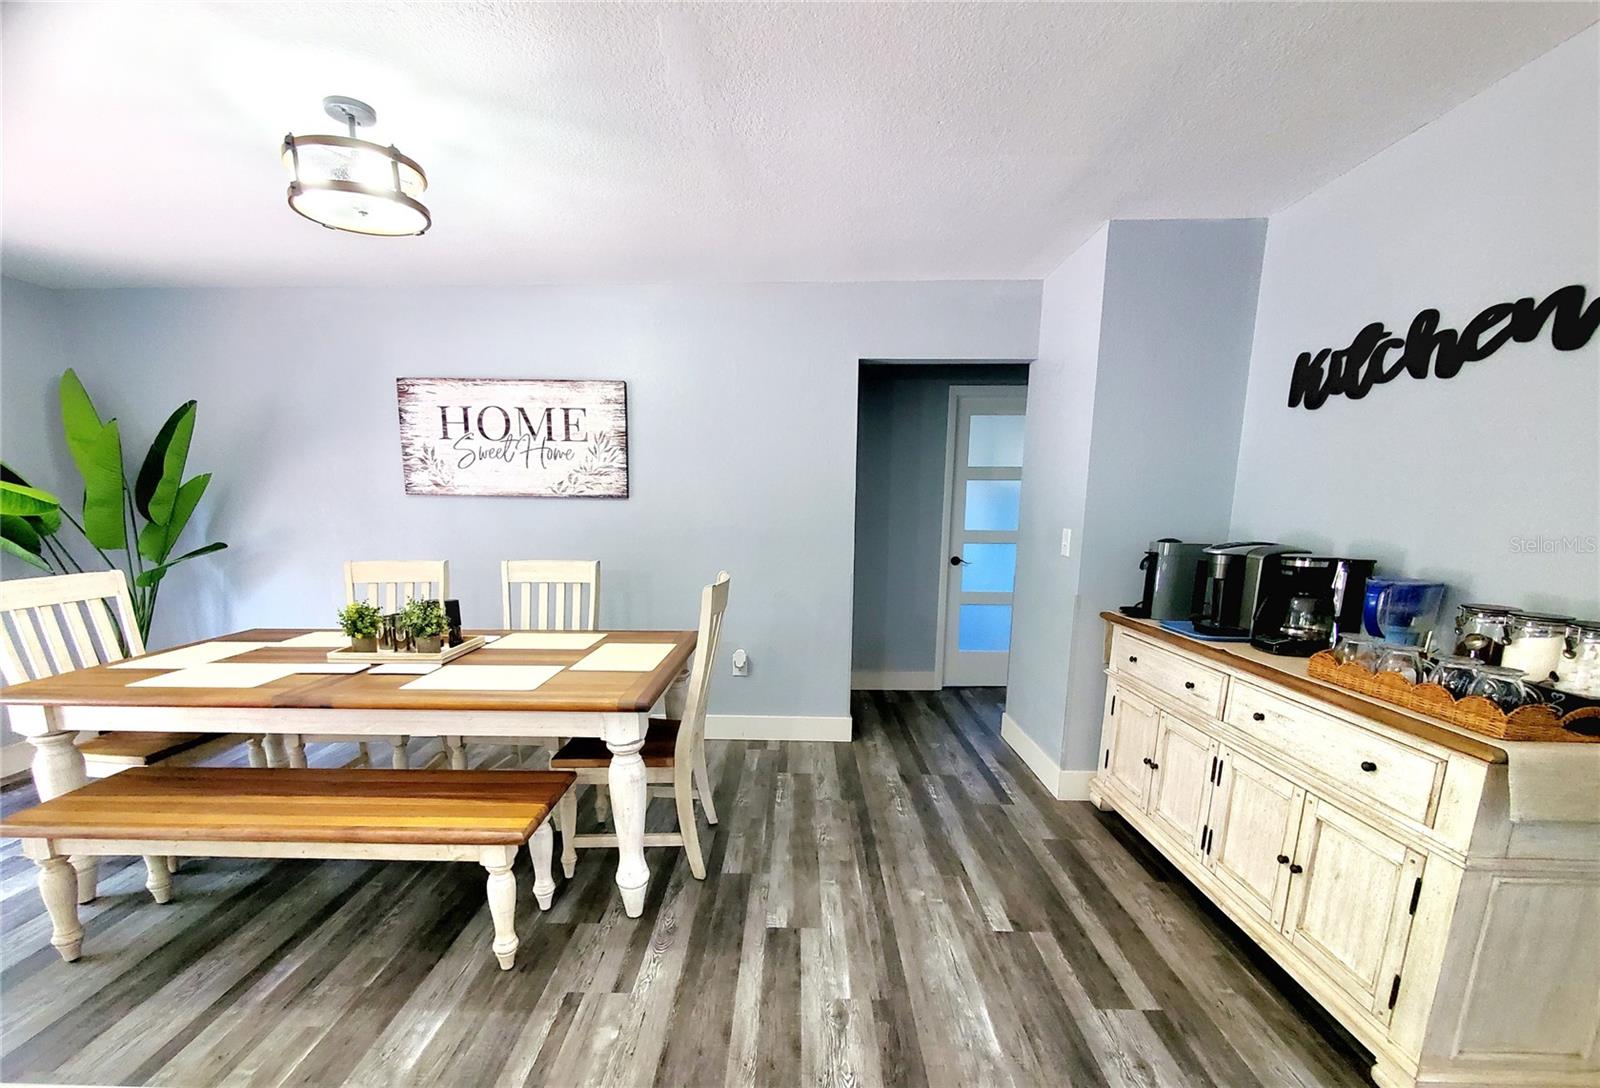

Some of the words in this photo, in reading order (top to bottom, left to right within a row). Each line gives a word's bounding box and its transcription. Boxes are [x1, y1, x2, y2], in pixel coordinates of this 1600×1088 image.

[438, 405, 589, 443] HOME
[453, 433, 517, 469] Sweet
[514, 432, 575, 469] Home
